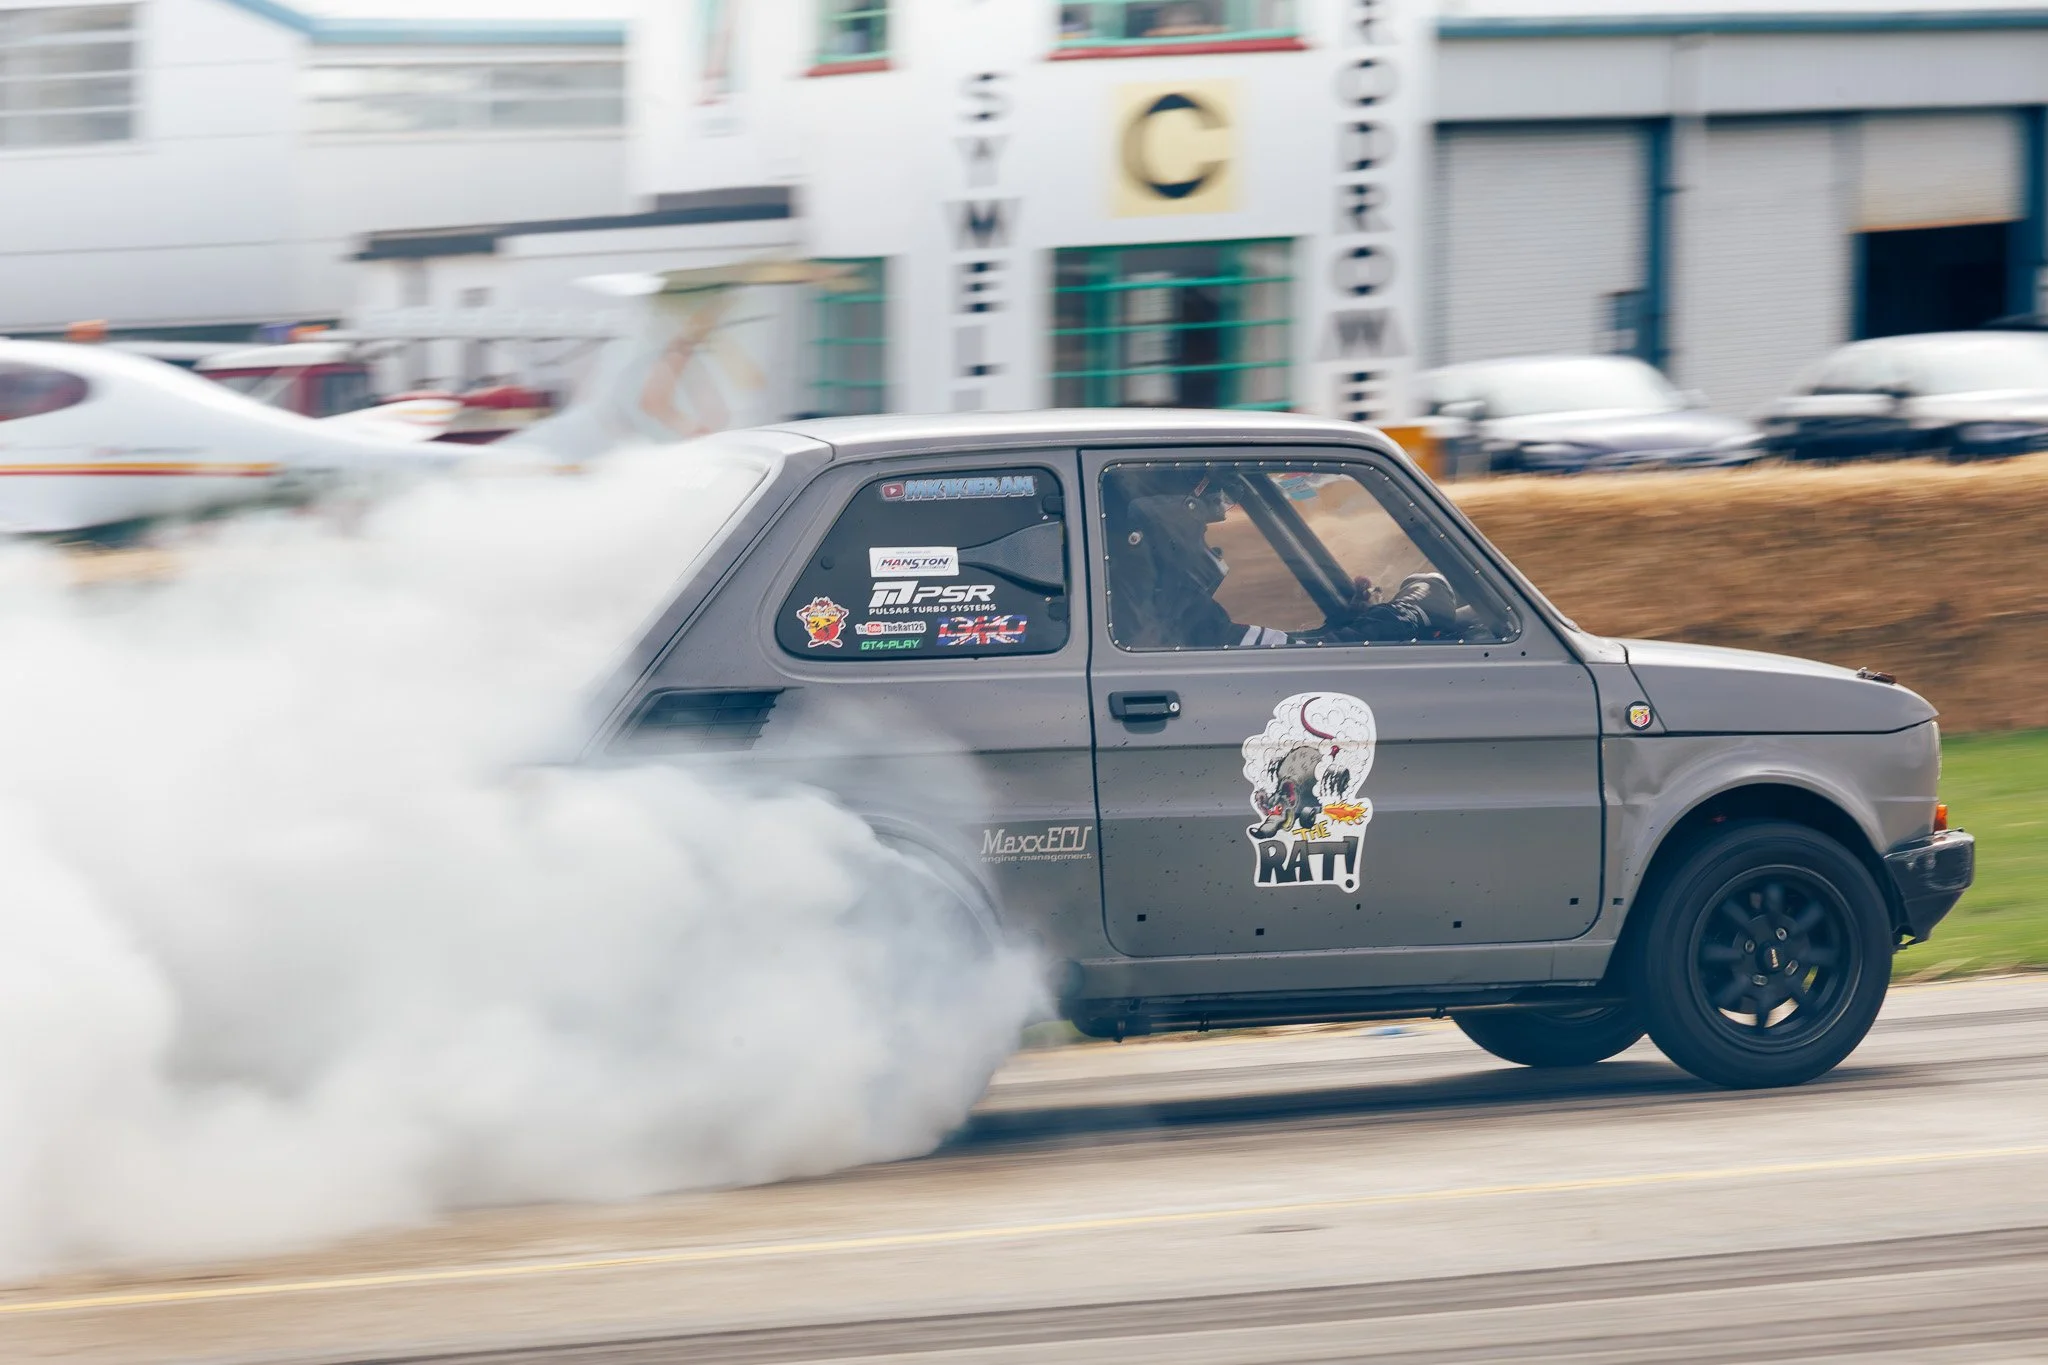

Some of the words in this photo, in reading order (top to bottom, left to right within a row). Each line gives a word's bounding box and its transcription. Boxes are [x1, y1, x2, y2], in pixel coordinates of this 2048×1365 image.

[1118, 93, 1232, 199] C
[881, 557, 949, 569] MANSTON
[869, 607, 910, 615] PULSAR
[951, 603, 996, 612] SYSTEMS
[861, 639, 920, 650] GT4-PLAY
[1292, 821, 1330, 841] THE
[981, 826, 1092, 855] MaxxECU
[981, 853, 1017, 863] engine
[1019, 852, 1092, 862] management
[1257, 835, 1359, 888] RAT!
